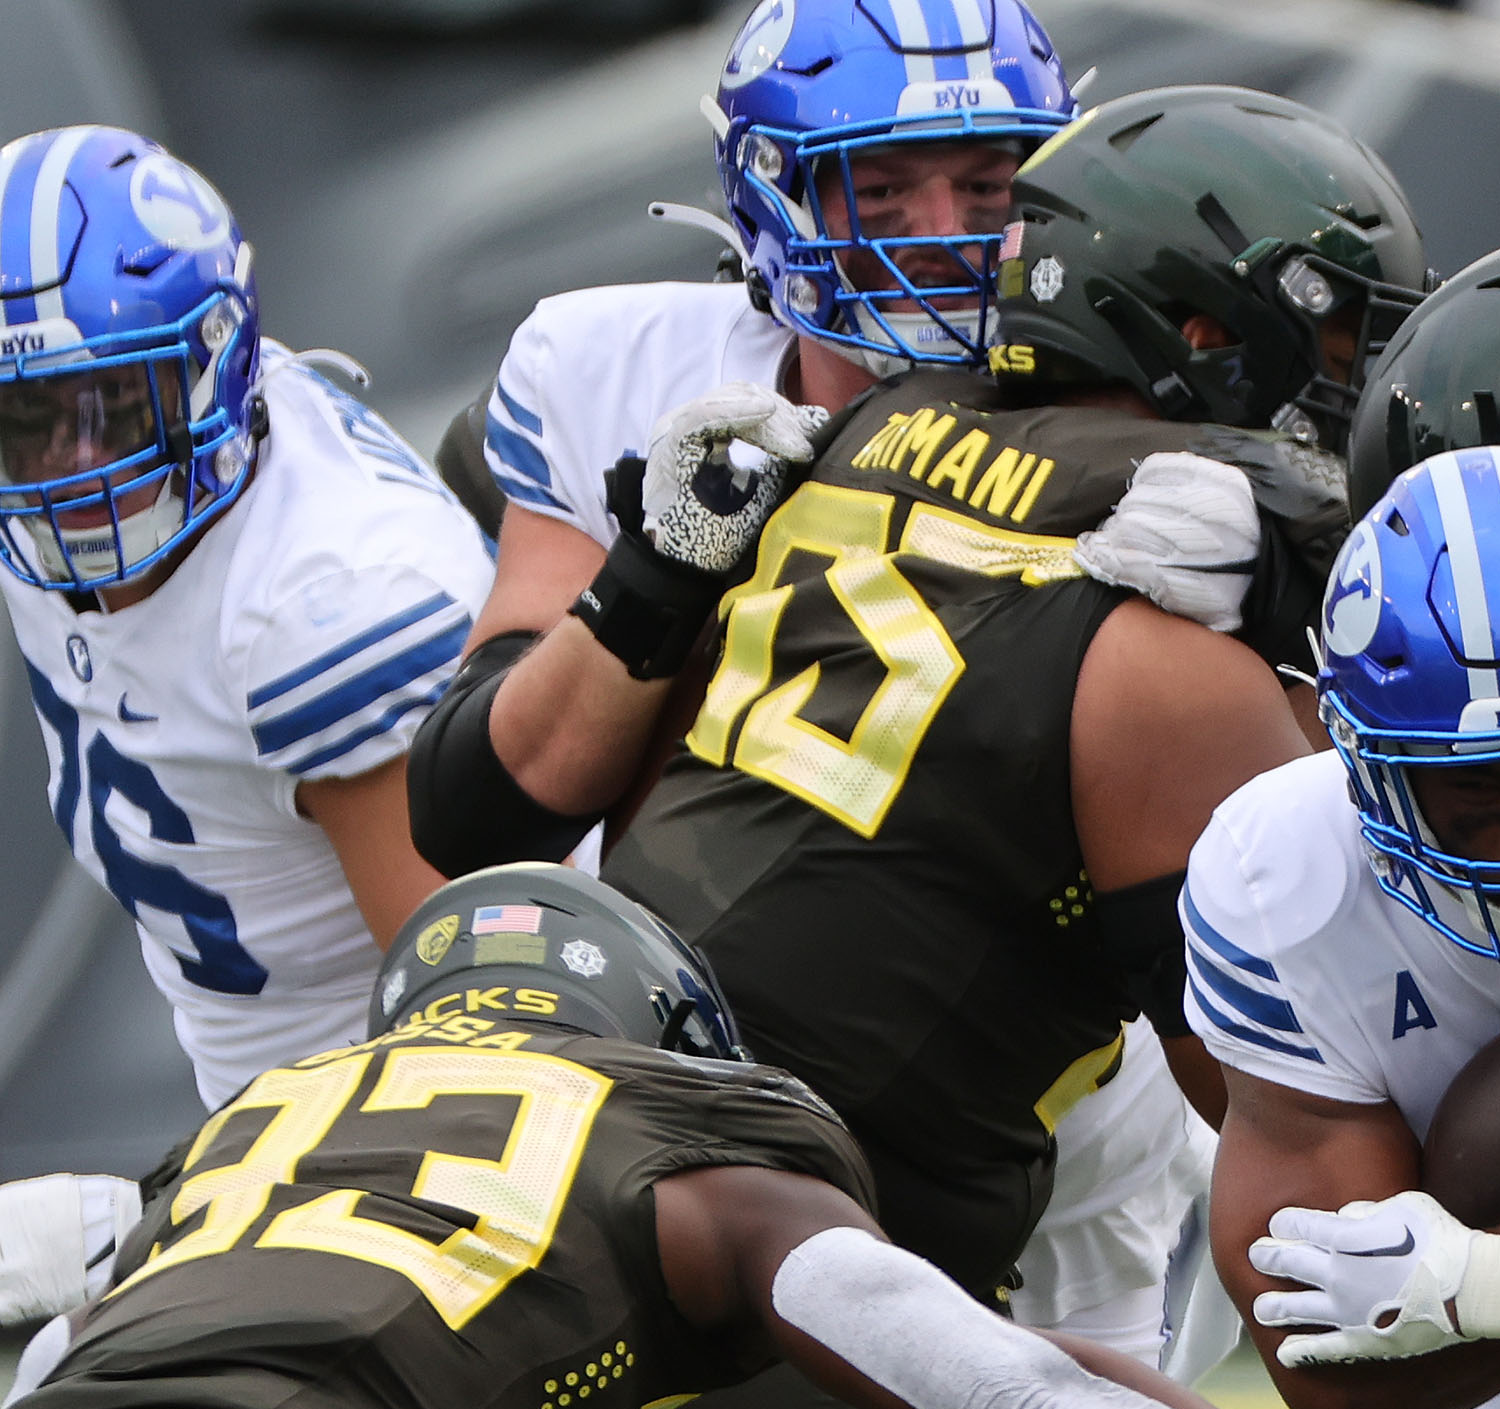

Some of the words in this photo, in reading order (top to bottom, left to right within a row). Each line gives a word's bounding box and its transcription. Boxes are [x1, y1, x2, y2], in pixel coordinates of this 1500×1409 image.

[935, 86, 981, 109] BYU
[1, 330, 45, 354] BYU
[1392, 970, 1438, 1040] A
